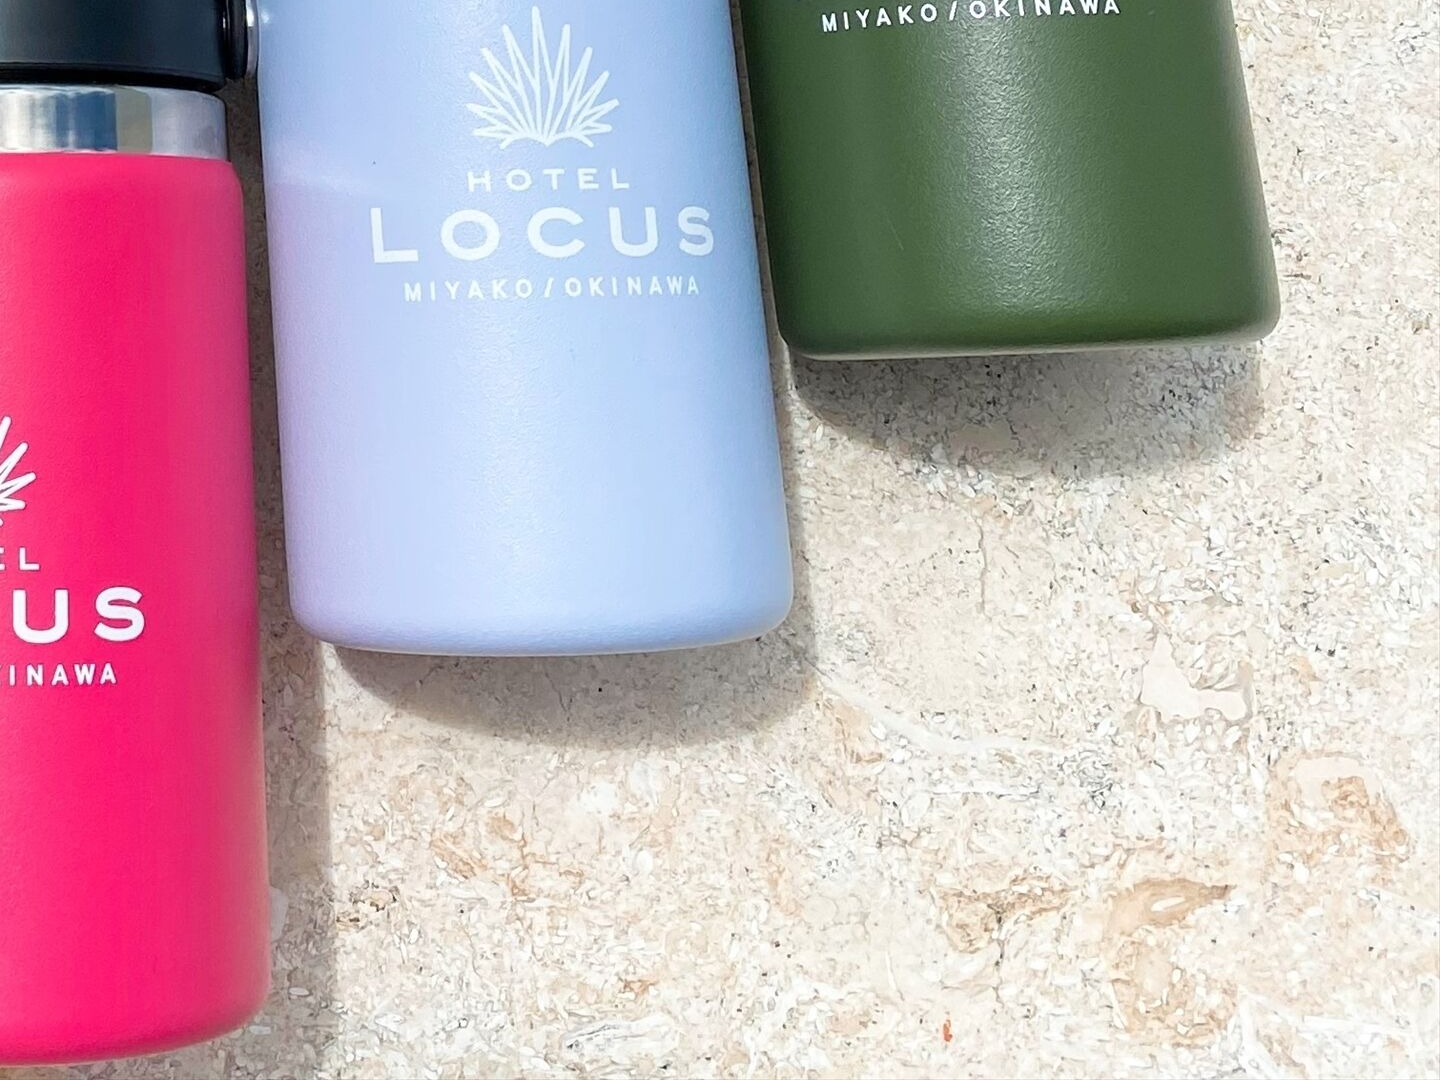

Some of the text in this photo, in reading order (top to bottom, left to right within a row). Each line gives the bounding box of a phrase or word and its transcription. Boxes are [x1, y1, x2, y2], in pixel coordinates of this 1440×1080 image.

[466, 167, 630, 193] HOTEL
[369, 206, 714, 264] LOCUS
[404, 275, 700, 302] MIYAKO/OKINAWA
